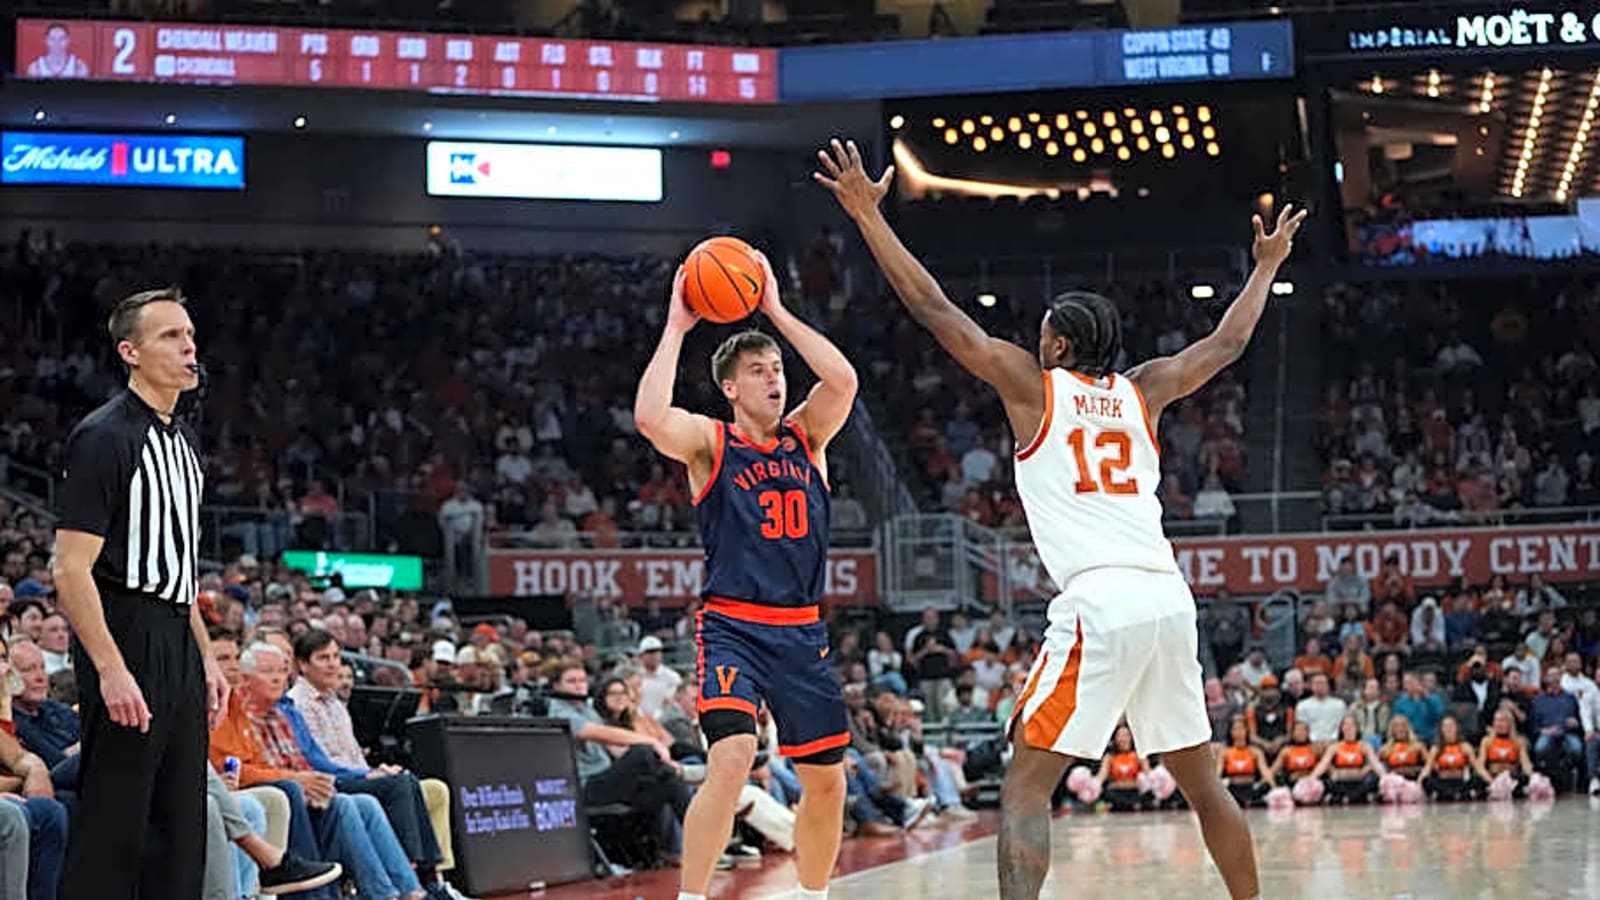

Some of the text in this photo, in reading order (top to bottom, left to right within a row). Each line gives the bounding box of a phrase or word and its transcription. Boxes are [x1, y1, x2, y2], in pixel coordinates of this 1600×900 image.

[1456, 9, 1555, 47] MOËT
[1560, 12, 1587, 43] &
[112, 28, 136, 74] 2
[133, 148, 238, 175] ULTRA
[1073, 394, 1124, 418] MARK
[1067, 428, 1138, 494] 12
[758, 490, 809, 539] 30
[513, 559, 623, 597] HOOK
[1240, 547, 1297, 584] TO
[1316, 540, 1472, 582] MOODY
[715, 665, 739, 694] V
